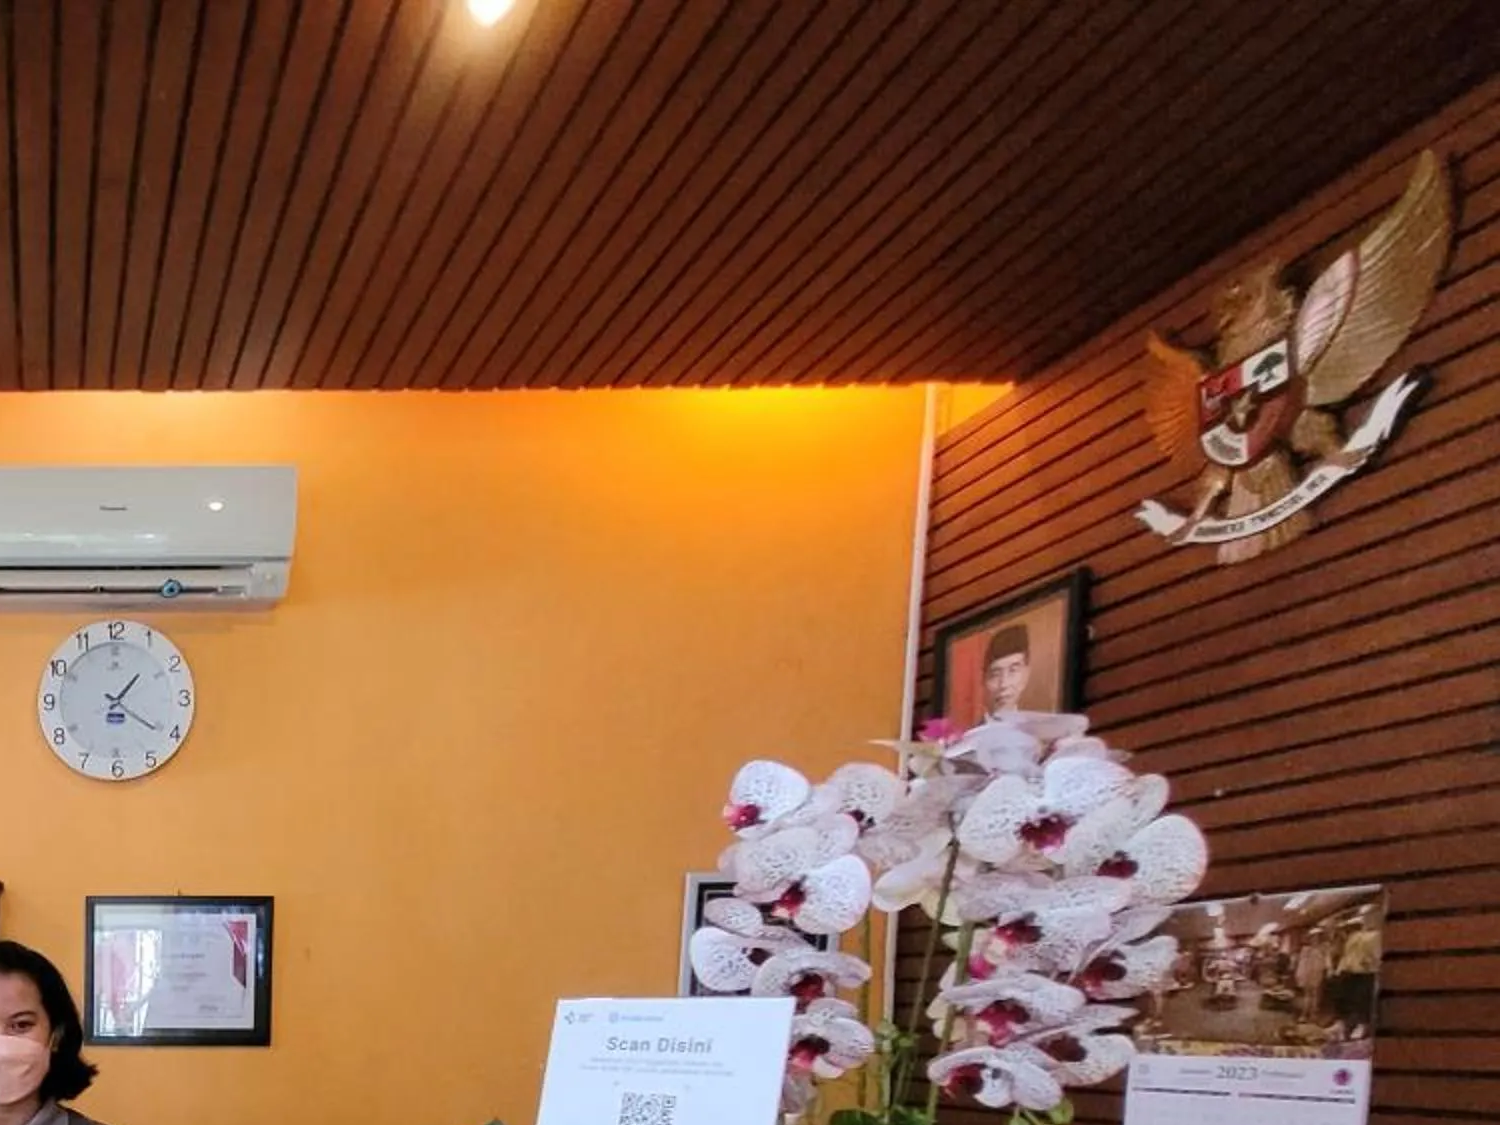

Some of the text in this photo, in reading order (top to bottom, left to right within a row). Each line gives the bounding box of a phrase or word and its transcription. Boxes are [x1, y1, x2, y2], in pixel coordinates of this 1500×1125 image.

[108, 622, 125, 641] 12
[146, 630, 153, 648] 1
[77, 632, 89, 652] 11
[50, 659, 67, 678] 10
[169, 656, 181, 673] 2
[43, 693, 56, 711] 9
[179, 690, 191, 707] 3
[53, 727, 66, 745] 8
[169, 724, 182, 743] 4
[78, 752, 90, 769] 7
[145, 751, 158, 768] 5
[111, 760, 125, 778] 6
[606, 1036, 714, 1054] Scan Disini
[1215, 1065, 1259, 1080] 2023
